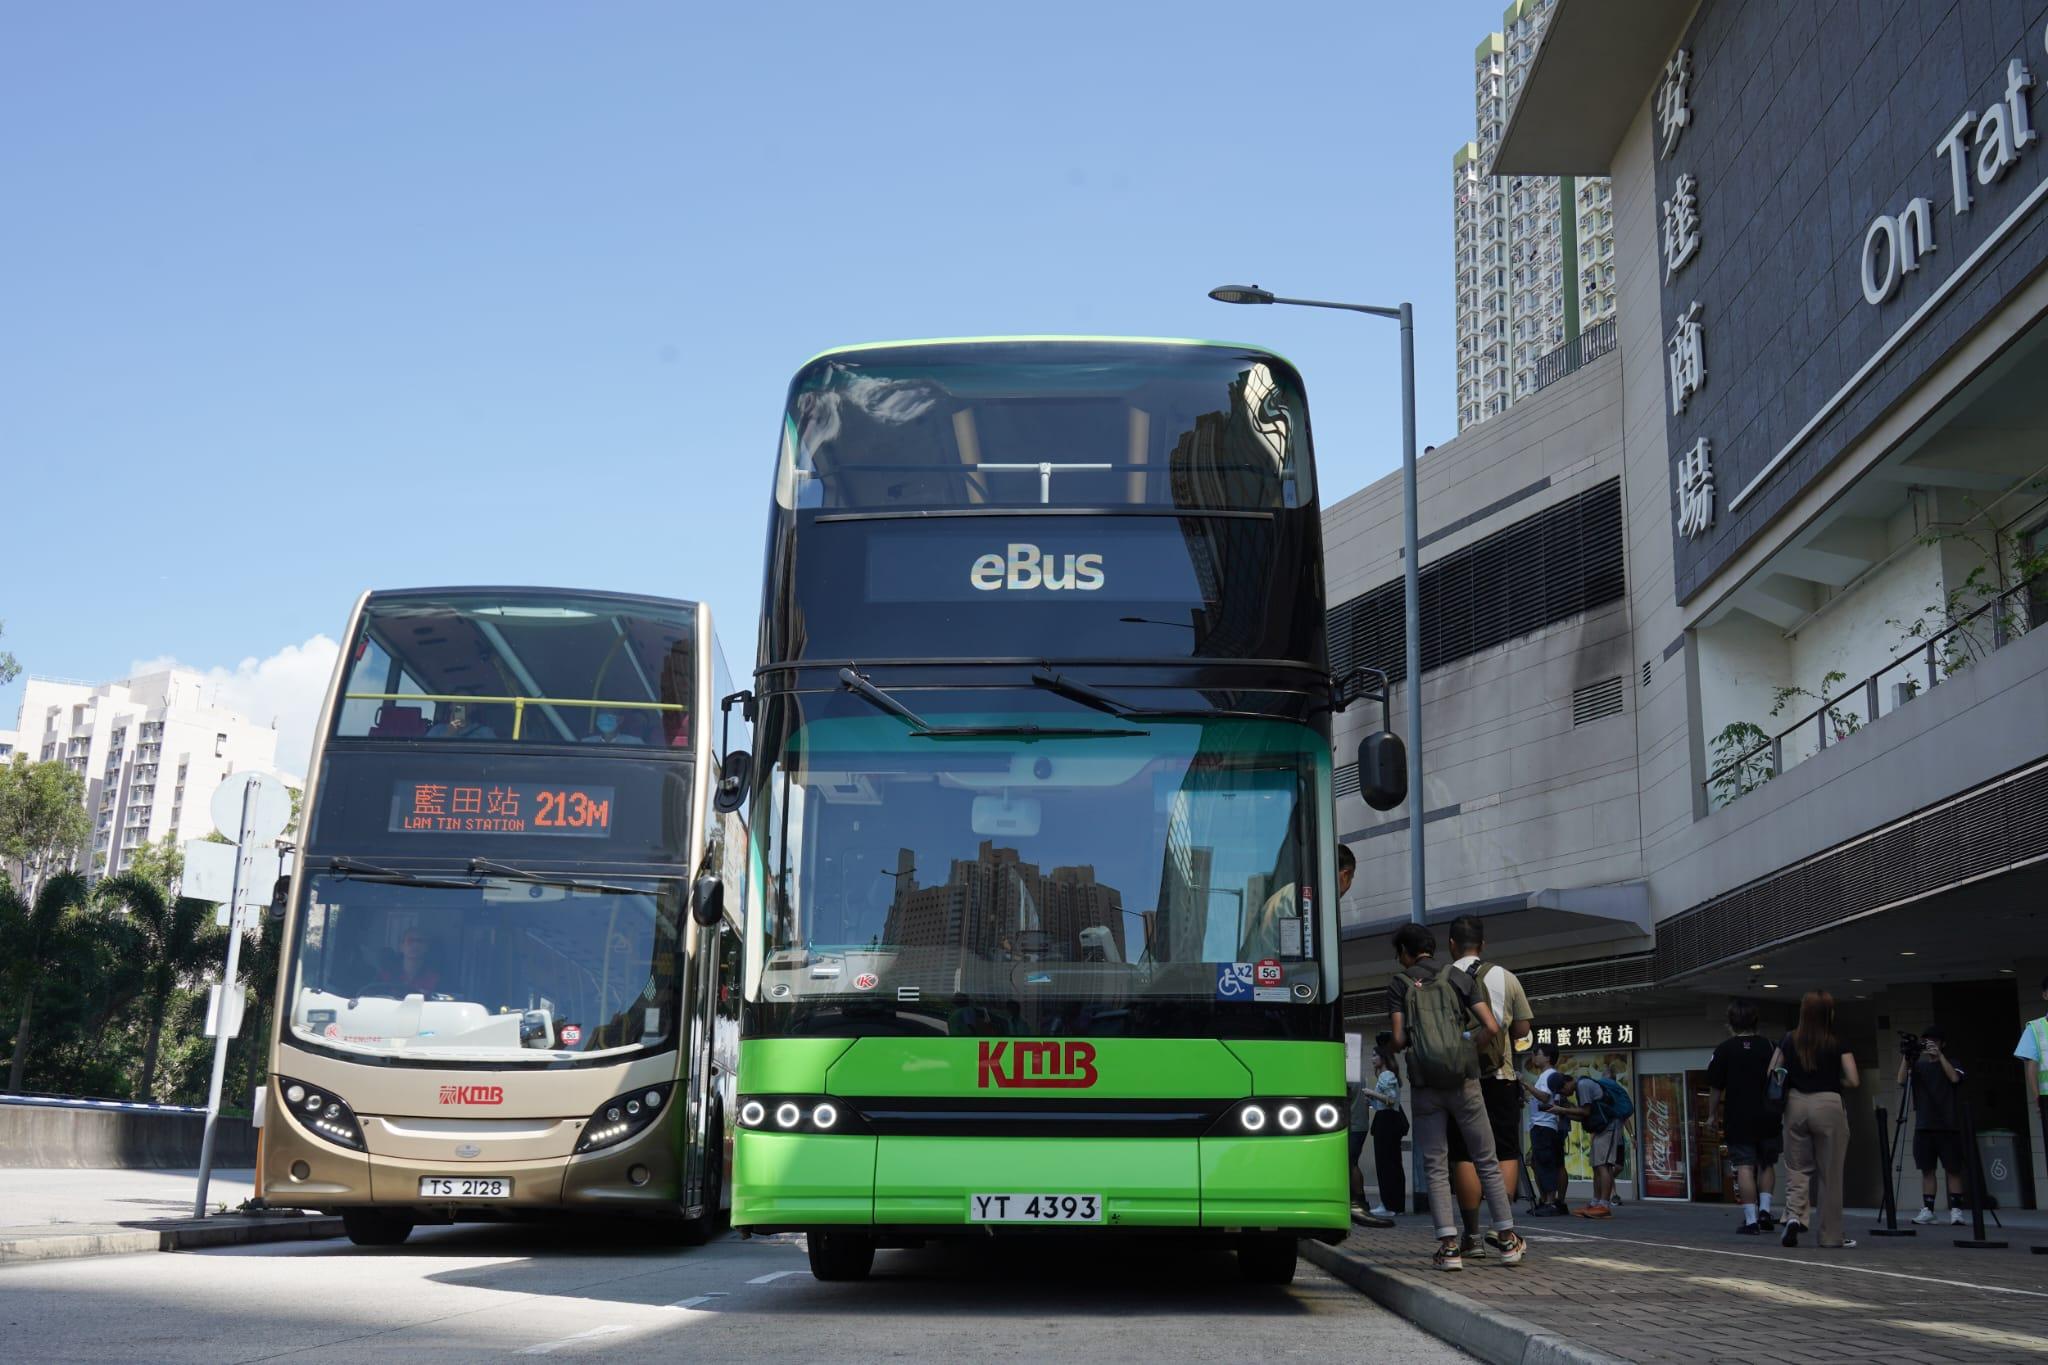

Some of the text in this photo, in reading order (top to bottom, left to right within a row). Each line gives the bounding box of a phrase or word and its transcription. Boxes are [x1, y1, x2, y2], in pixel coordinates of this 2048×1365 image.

[1861, 58, 2036, 305] On Tat
[1656, 48, 1716, 541] 安達商場
[970, 543, 1105, 591] eBus
[413, 784, 520, 817] 藍田站
[534, 791, 609, 828] 213M
[404, 816, 525, 832] LAM TIN STATION
[1237, 965, 1252, 978] x2
[1537, 1024, 1634, 1047] 甜蜜烘焙坊
[978, 1041, 1098, 1088] KMB
[457, 1086, 503, 1105] KMB
[430, 1180, 502, 1195] TS 2128
[976, 1196, 1096, 1219] YT 4393
